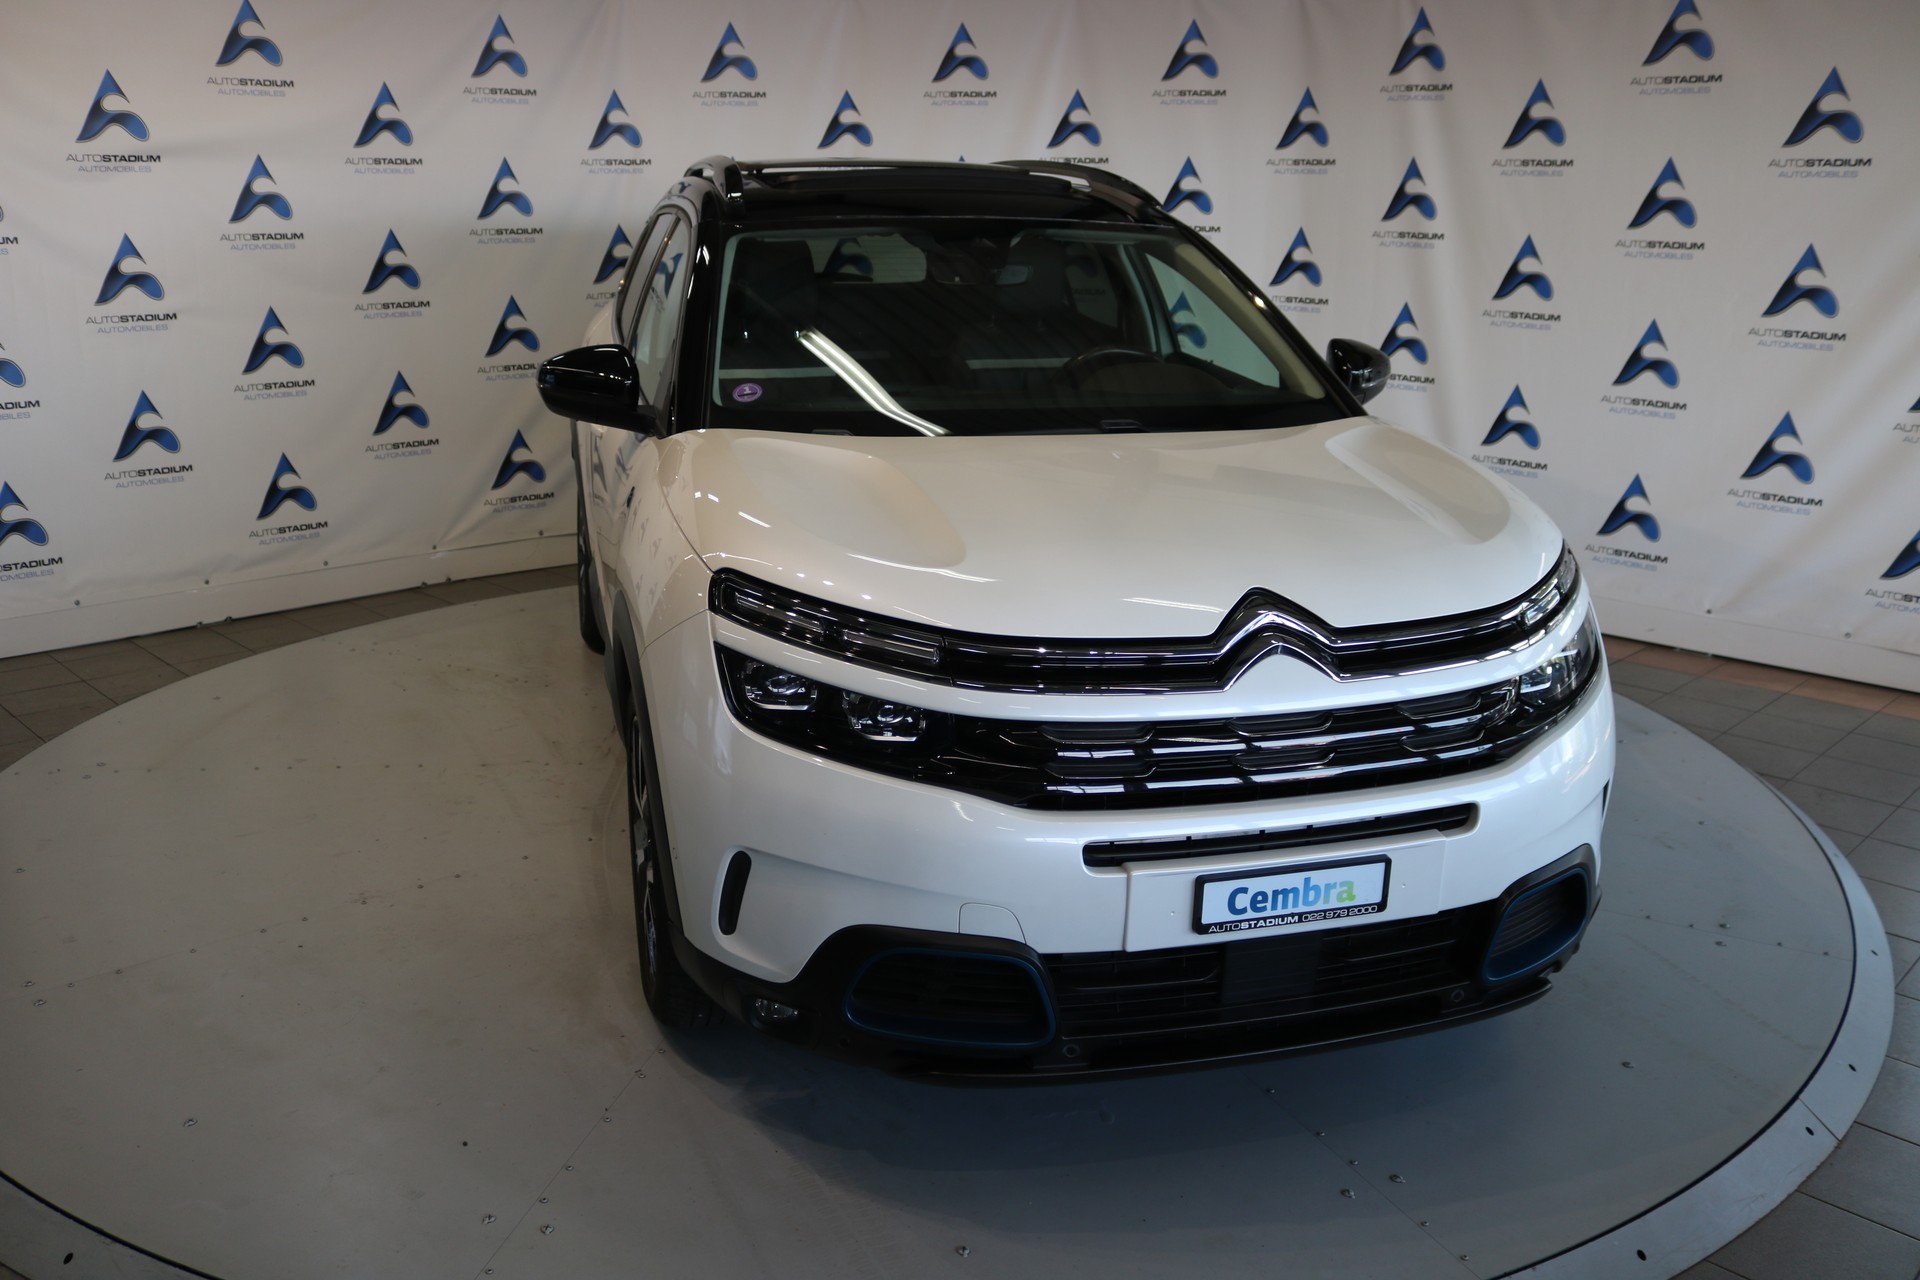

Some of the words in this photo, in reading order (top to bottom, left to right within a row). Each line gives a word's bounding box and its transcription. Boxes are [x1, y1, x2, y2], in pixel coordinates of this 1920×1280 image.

[207, 76, 294, 88] AUTOSTADIUM
[1630, 74, 1723, 86] AUTOSTADIUM
[217, 88, 286, 97] AUTOMOBILES
[463, 86, 536, 96] AUTOSTADIUM
[1152, 89, 1226, 98] AUTOSTADIUM
[1380, 83, 1453, 93] AUTOSTADIUM
[1639, 85, 1712, 96] AUTOMOBILES
[692, 90, 766, 99] AUTOSTADIUM
[923, 90, 997, 99] AUTOSTADIUM
[1387, 94, 1445, 102] AUTOMOBILES
[471, 97, 529, 105] AUTOMOBILES
[1160, 98, 1218, 106] AUTOMOBILES
[66, 153, 161, 163] AUTOSTADIUM
[345, 157, 422, 166] AUTOSTADIUM
[580, 158, 651, 167] AUTOSTADIUM
[1266, 158, 1336, 167] AUTOSTADIUM
[1492, 158, 1574, 168] AUTOSTADIUM
[1768, 157, 1872, 168] AUTOSTADIUM
[78, 165, 152, 173] AUTOMOBILES
[588, 167, 645, 175] AUTOMOBILES
[1274, 167, 1328, 175] AUTOMOBILES
[1500, 168, 1563, 177] AUTOMOBILES
[1778, 169, 1859, 178] AUTOMOBILES
[220, 233, 304, 242] AUTOSTADIUM
[469, 228, 543, 236] AUTOSTADIUM
[1372, 229, 1444, 241] AUTOSTADIUM
[230, 241, 296, 251] AUTOMOBILES
[1379, 240, 1436, 249] AUTOMOBILES
[1615, 239, 1705, 250] AUTOSTADIUM
[1624, 249, 1694, 261] AUTOMOBILES
[1272, 295, 1329, 305] TOSTADIUM
[354, 301, 430, 312] AUTOSTADIUM
[86, 312, 177, 325] AUTOSTADIUM
[363, 311, 423, 320] AUTOMOBILES
[1483, 308, 1561, 322] AUTOSTADIUM
[97, 323, 168, 334] AUTOMOBILES
[1489, 319, 1552, 331] AUTOMOBILES
[1748, 326, 1846, 342] AUTOSTADIUM
[1757, 338, 1834, 353] AUTOMOBILES
[1389, 373, 1435, 384] STADIUM
[234, 379, 315, 393] AUTOSTADIUM
[743, 386, 752, 394] 1
[244, 389, 307, 401] AUTOMOBILES
[1601, 393, 1687, 411] AUTOSTADIUM
[1609, 405, 1677, 420] AUTOMOBILES
[365, 438, 439, 453] AUTOSTADIUM
[373, 449, 431, 461] AUTOMOBILES
[1471, 452, 1548, 471] AUTOSTADIUM
[104, 464, 193, 481] AUTOSTADIUM
[115, 474, 184, 489] AUTOMOBILES
[484, 492, 554, 508] AUTOSTADIUM
[1727, 488, 1823, 507] AUTOSTADIUM
[492, 500, 547, 515] AUTOMOBILES
[1737, 500, 1811, 516] AUTOMOBILES
[248, 521, 328, 538] AUTOSTADIUM
[258, 532, 320, 547] AUTOMOBILES
[1585, 543, 1668, 565] AUTOSTADIUM
[0, 556, 63, 572] STADIUM
[1592, 554, 1658, 572] AUTOMOBILES
[0, 568, 55, 582] OMOBILES
[1865, 588, 1920, 604] AUTOST
[1227, 877, 1356, 915] Cembra
[1208, 915, 1299, 933] AUTOSTADIUM
[1302, 913, 1325, 922] 022
[1326, 910, 1348, 919] 979
[1349, 905, 1378, 916] 2000
